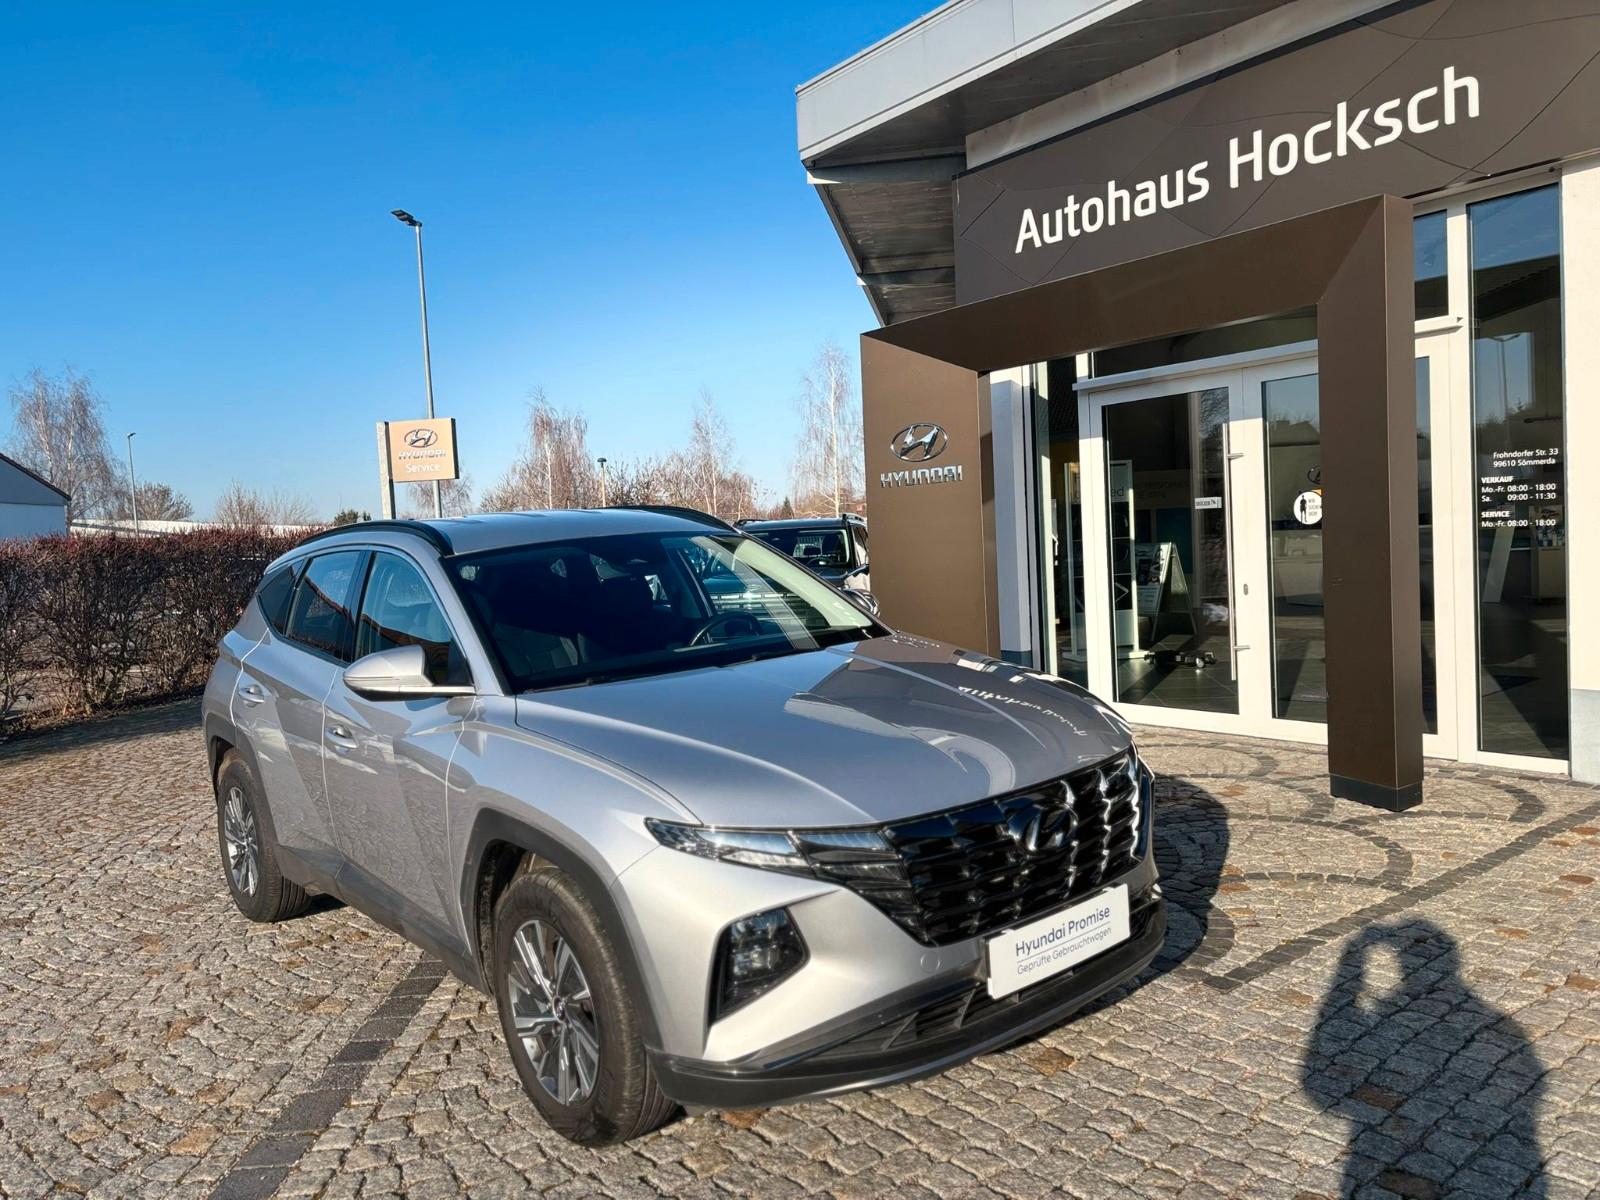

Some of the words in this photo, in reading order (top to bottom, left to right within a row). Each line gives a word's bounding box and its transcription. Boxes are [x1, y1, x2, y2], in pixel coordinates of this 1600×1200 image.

[1015, 161, 1210, 254] Autohaus
[1229, 66, 1480, 188] Hocksch
[1493, 450, 1534, 459] Frohndorfer
[1535, 448, 1547, 456] Str.
[1548, 447, 1559, 455] 33
[405, 463, 441, 473] Service
[1493, 459, 1516, 468] 99610
[1517, 458, 1556, 466] Sömmerda
[880, 465, 963, 488] HYUNDAI
[1507, 484, 1528, 492] 08:00
[1535, 483, 1556, 491] 18:00
[1507, 493, 1528, 501] 09:00
[1535, 492, 1556, 500] 11:30
[1481, 520, 1506, 528] Mo.-Fr.
[1507, 519, 1528, 527] 08:00
[1535, 518, 1556, 526] 18:00
[1016, 923, 1066, 956] Hyundai
[1068, 907, 1110, 934] Promise
[1017, 954, 1051, 975] Geprüfte
[1053, 927, 1111, 960] Gebrauchtwagen
